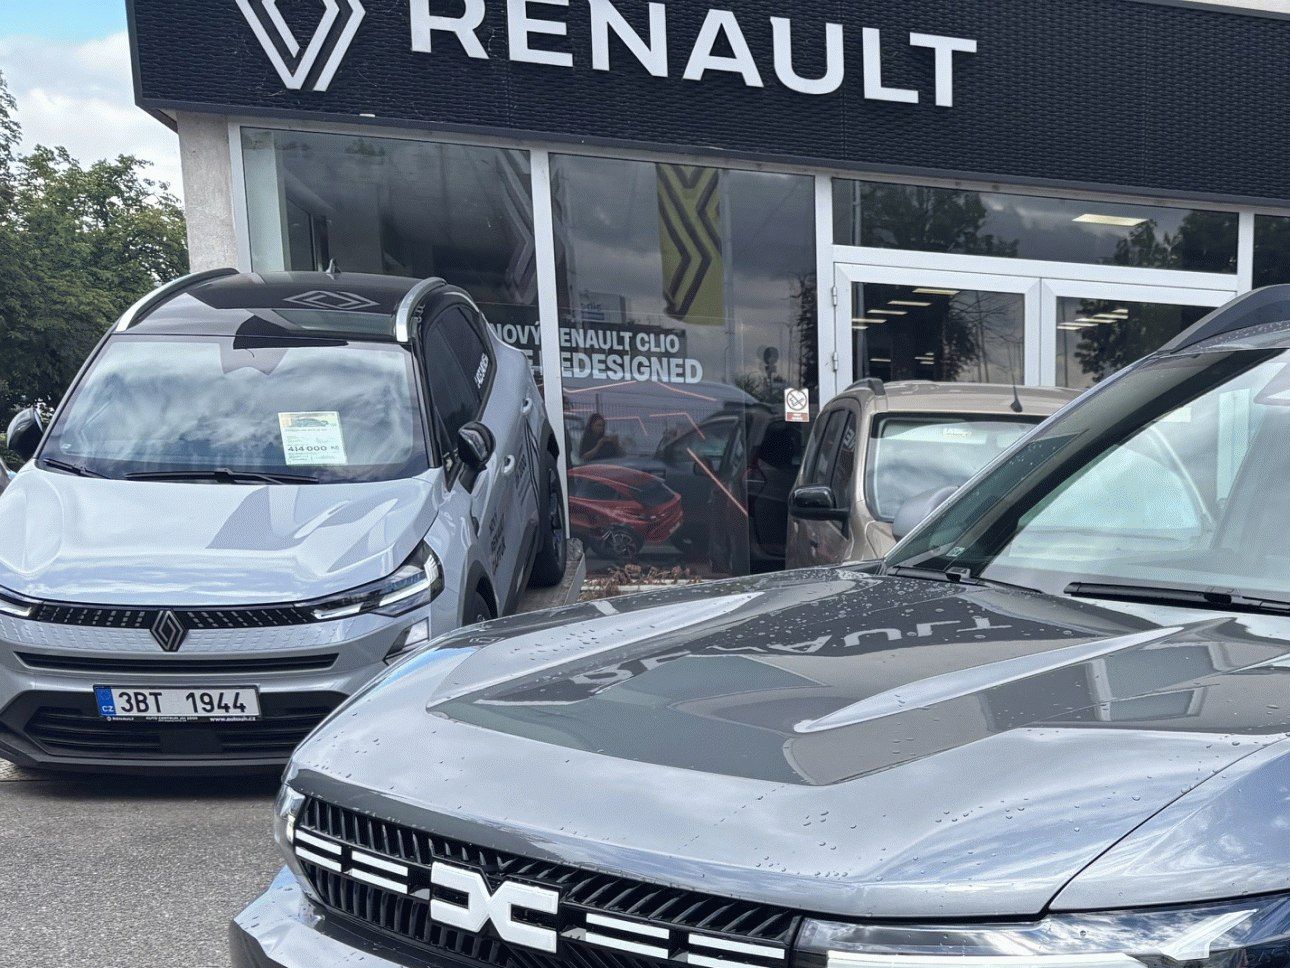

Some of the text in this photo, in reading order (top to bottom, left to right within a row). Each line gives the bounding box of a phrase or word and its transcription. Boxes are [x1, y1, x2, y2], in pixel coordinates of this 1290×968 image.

[409, 0, 977, 107] RENAULT
[559, 327, 633, 350] ENAULT
[636, 334, 680, 353] CLIO
[539, 350, 703, 384] EDESIGNED
[118, 691, 247, 713] 3BT 1944
